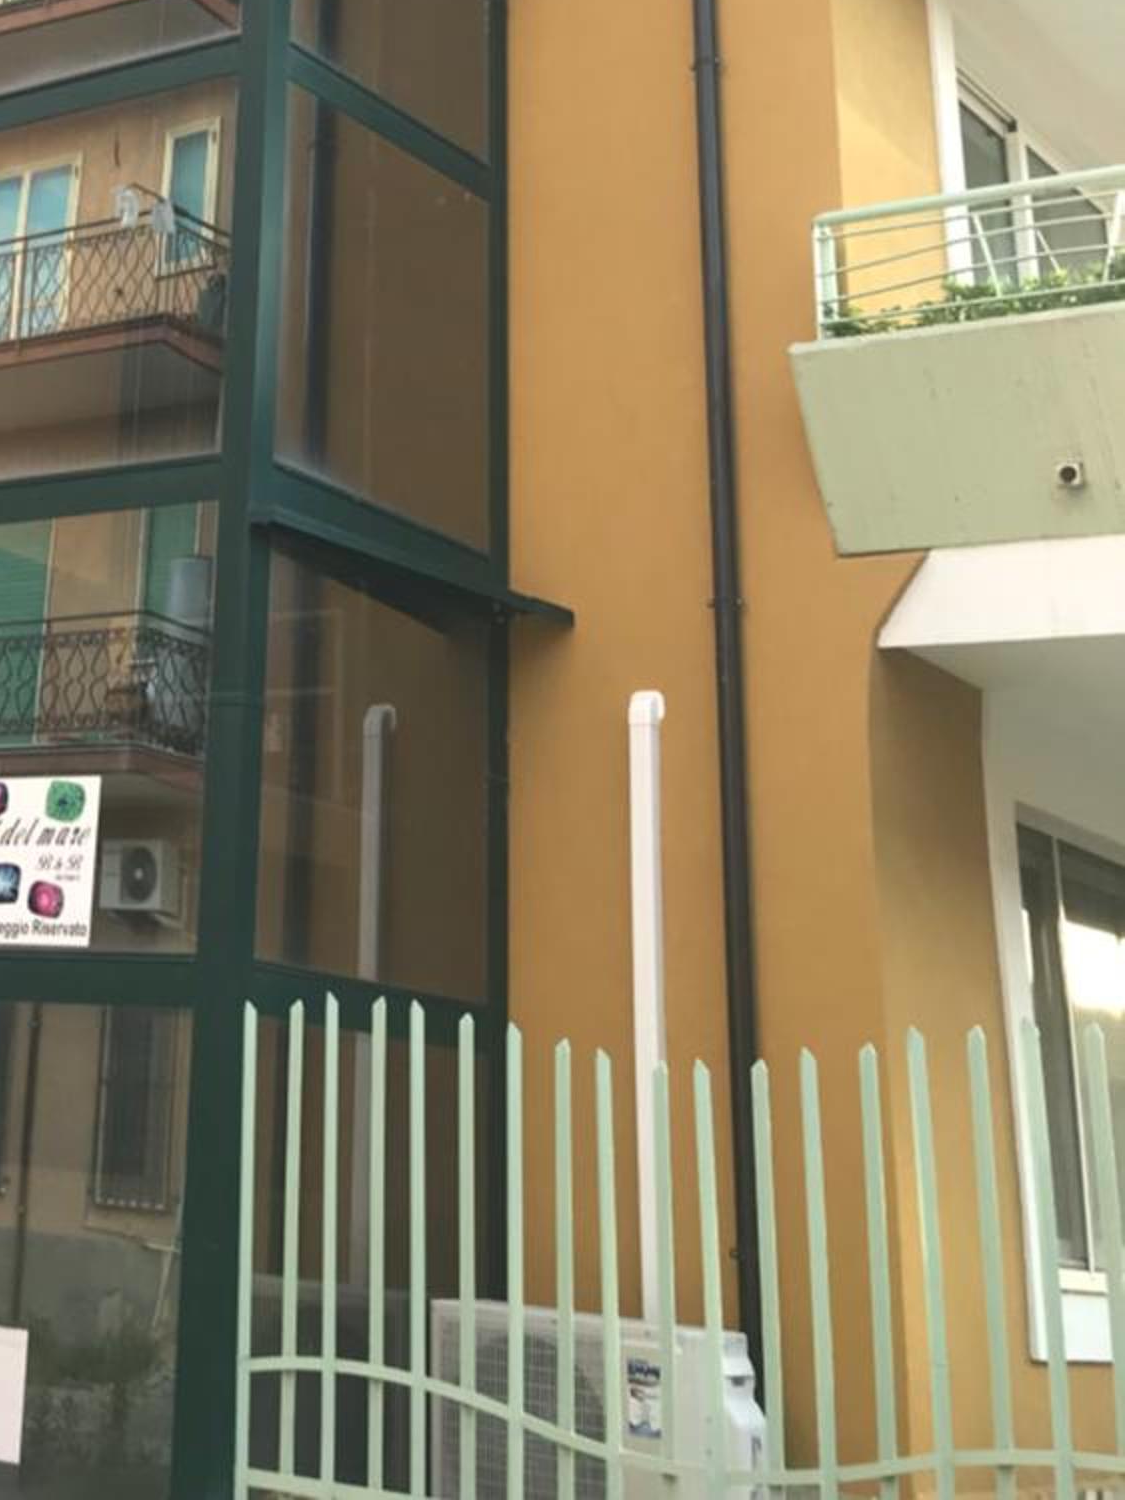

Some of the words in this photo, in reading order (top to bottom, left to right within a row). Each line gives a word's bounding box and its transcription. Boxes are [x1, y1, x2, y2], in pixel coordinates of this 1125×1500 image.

[0, 817, 39, 846] del
[36, 826, 91, 847] mare
[31, 918, 87, 937] Riservato
